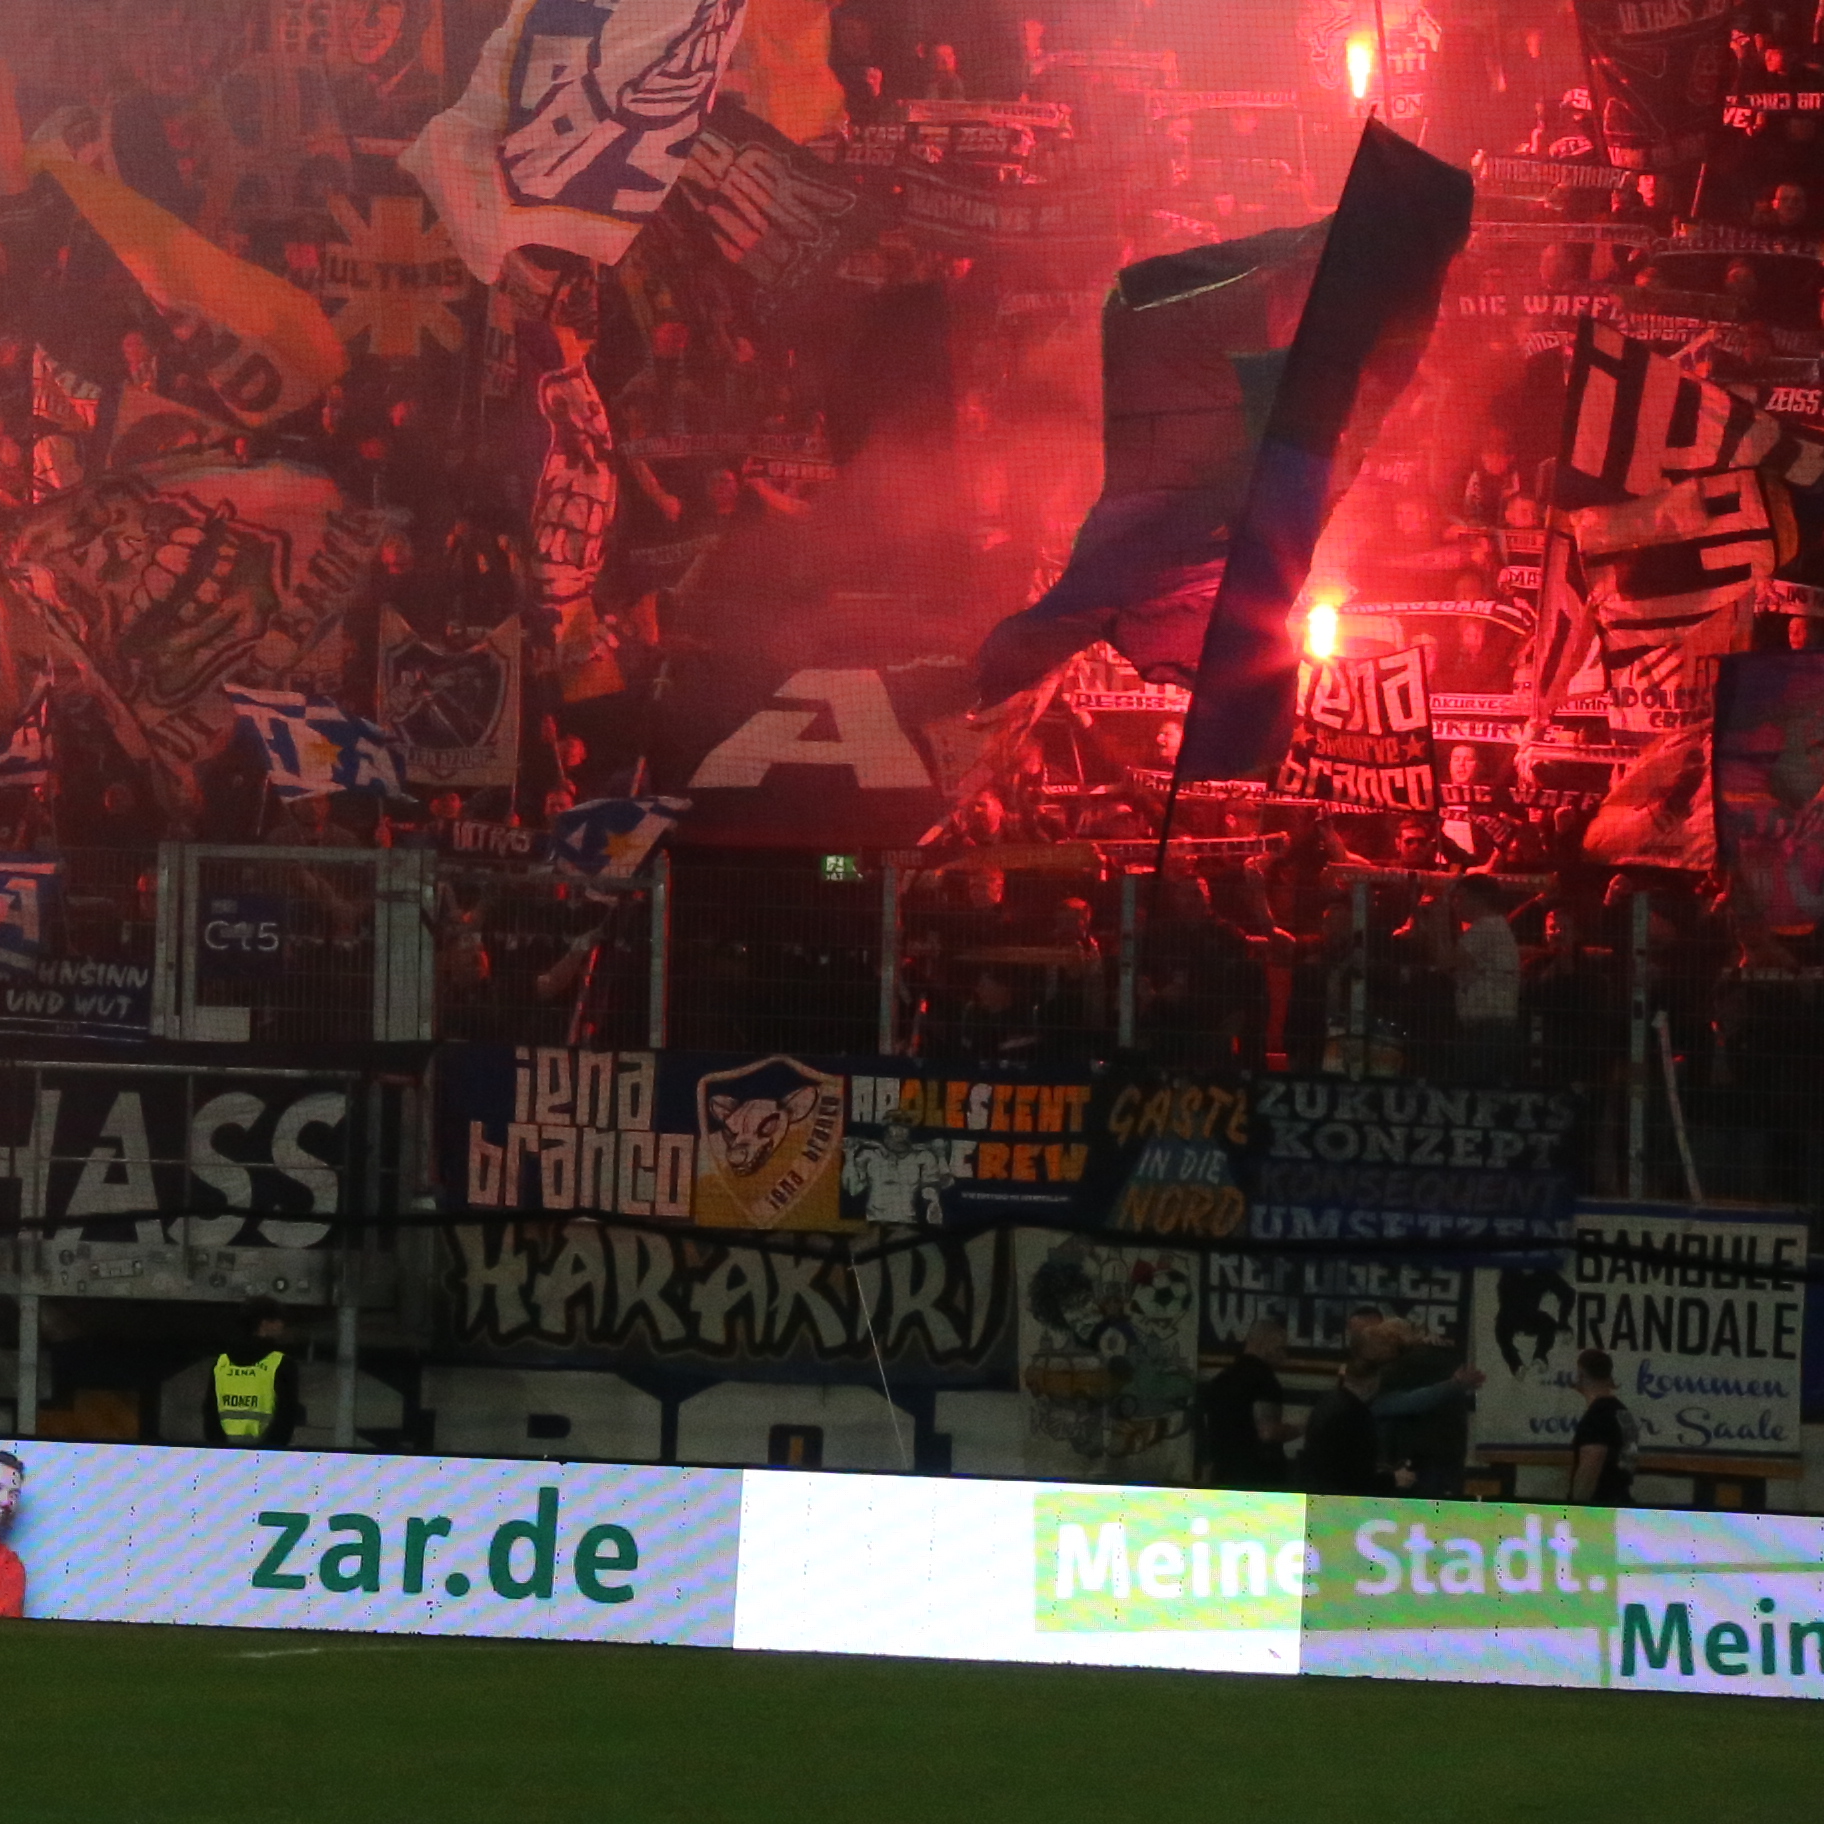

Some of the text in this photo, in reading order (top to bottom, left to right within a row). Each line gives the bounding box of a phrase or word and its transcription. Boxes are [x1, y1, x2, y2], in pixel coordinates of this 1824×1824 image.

[6, 987, 132, 1020] UND WUT
[852, 1075, 1092, 1133] ADOLESCENT
[1255, 1079, 1576, 1131] ZUKUNFTS
[1136, 1147, 1230, 1184] IN DIE
[1268, 1119, 1562, 1169] KONZEPT
[1117, 1184, 1247, 1240] NORD
[1259, 1161, 1570, 1214] KONSEQUENT
[454, 1220, 999, 1353] HARAKIRI
[1576, 1227, 1798, 1293] BAMBULE
[1577, 1290, 1799, 1361] RANDALE
[222, 1394, 259, 1408] RDNER
[1636, 1357, 1790, 1399] kommen
[1675, 1407, 1787, 1450] Saale
[251, 1486, 640, 1605] zar.de
[1056, 1516, 1609, 1600] Meine Stadt.
